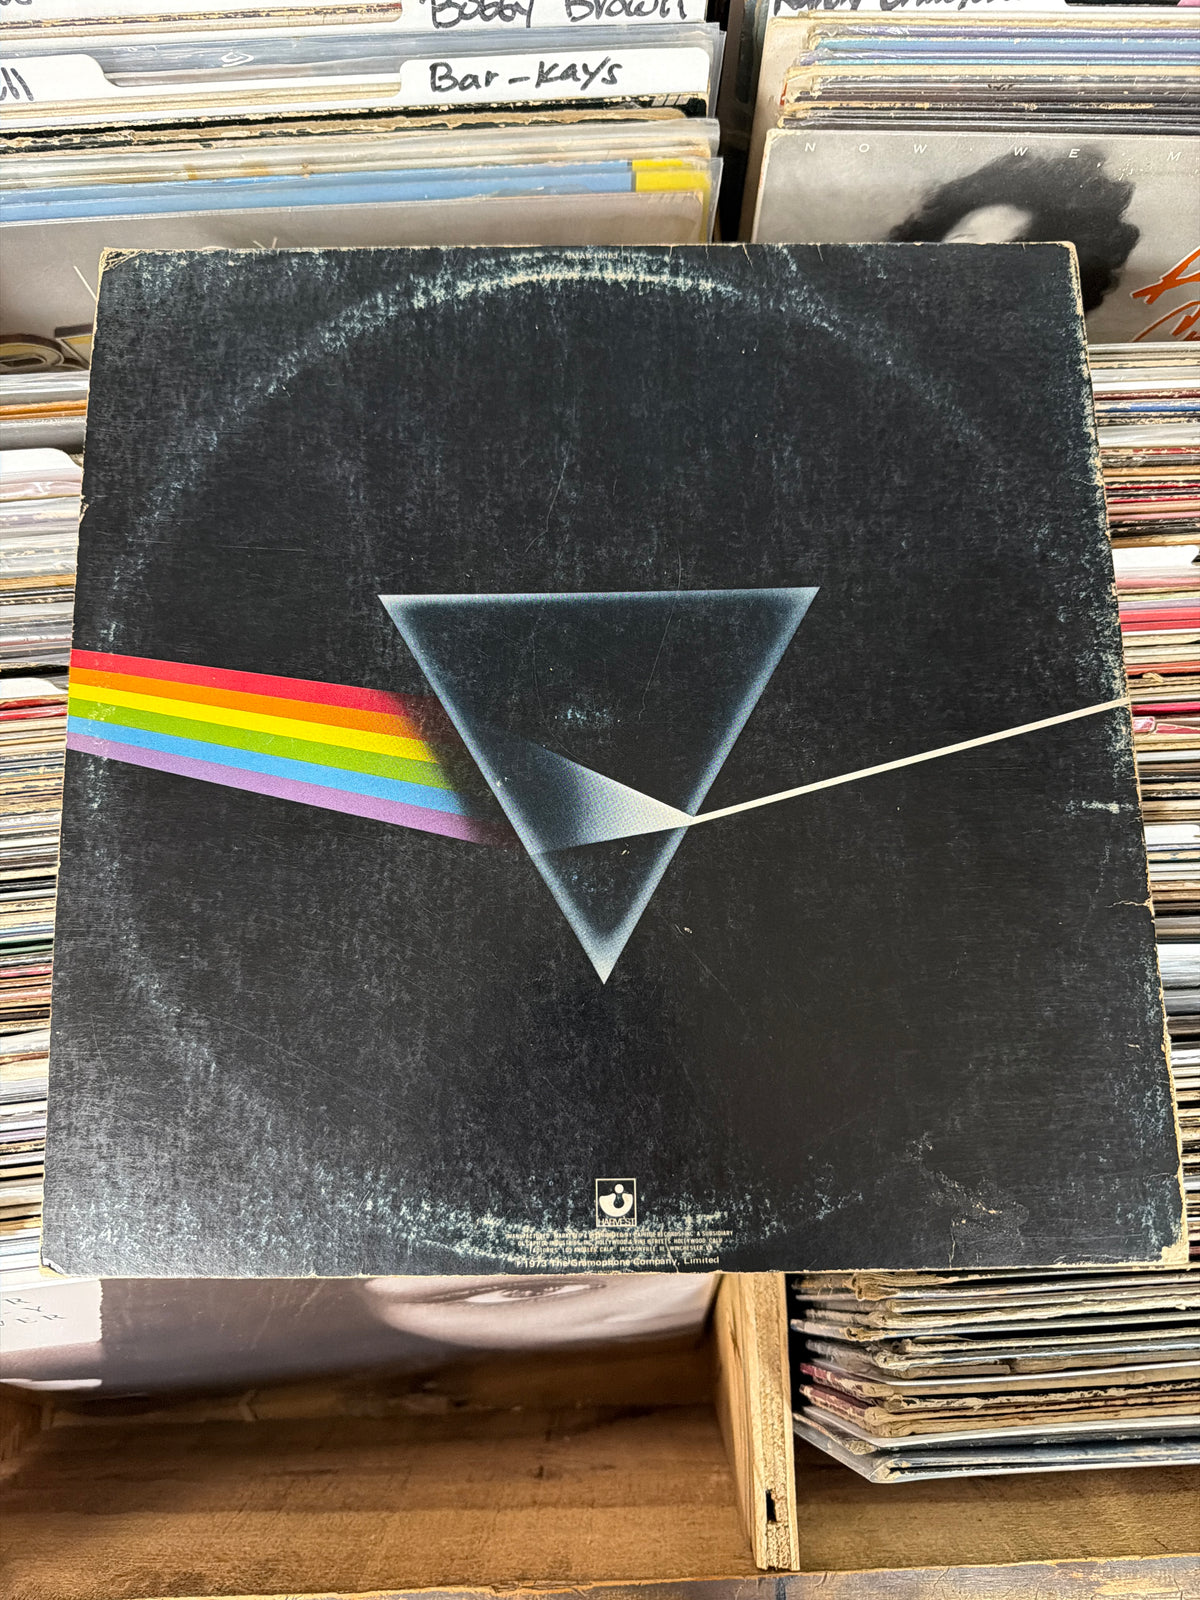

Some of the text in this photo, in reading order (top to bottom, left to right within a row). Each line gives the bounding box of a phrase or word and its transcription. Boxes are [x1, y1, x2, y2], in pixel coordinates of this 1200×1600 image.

[804, 142, 928, 154] NOW
[1013, 146, 1081, 159] WE
[598, 1217, 636, 1226] HARVEST
[524, 1259, 547, 1268] 1973
[550, 1258, 569, 1267] The
[570, 1257, 631, 1268] Gramophone
[632, 1257, 680, 1267] Company,
[683, 1255, 720, 1265] Limited
